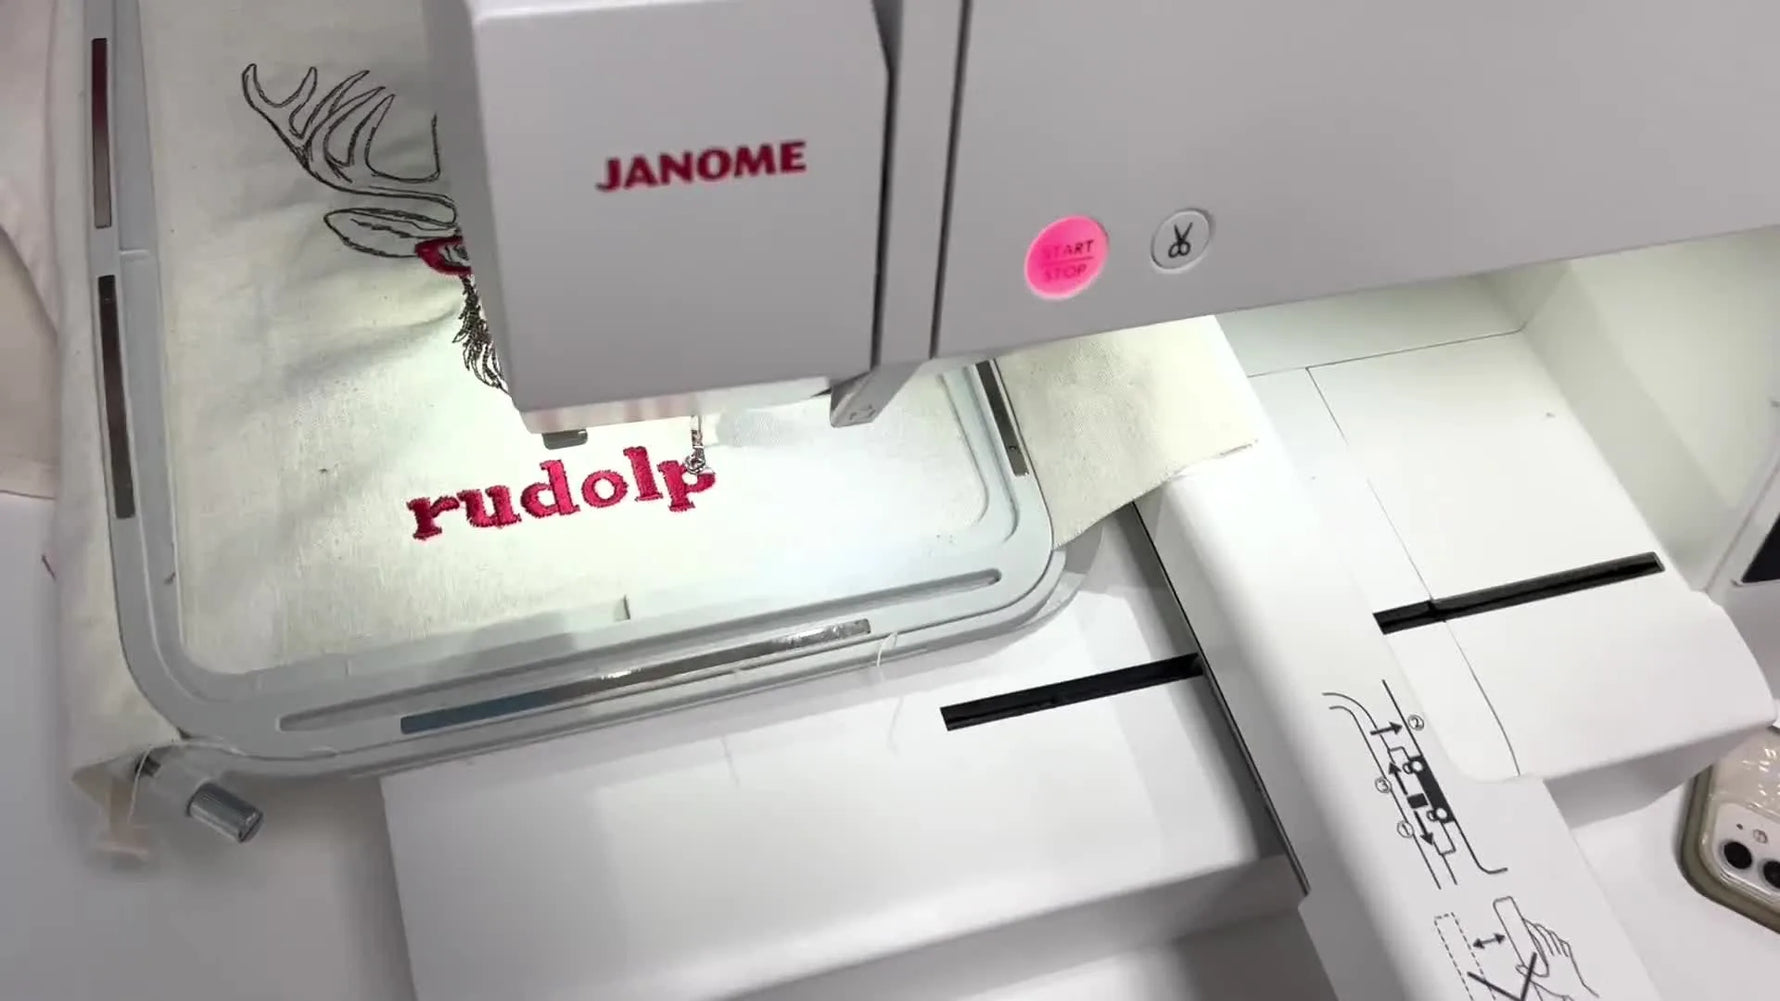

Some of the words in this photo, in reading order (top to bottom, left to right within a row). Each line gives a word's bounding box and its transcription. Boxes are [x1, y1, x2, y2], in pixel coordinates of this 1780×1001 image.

[595, 140, 806, 192] JANOME
[1041, 240, 1095, 259] START
[1043, 263, 1087, 281] STOP
[406, 446, 716, 540] rudolp
